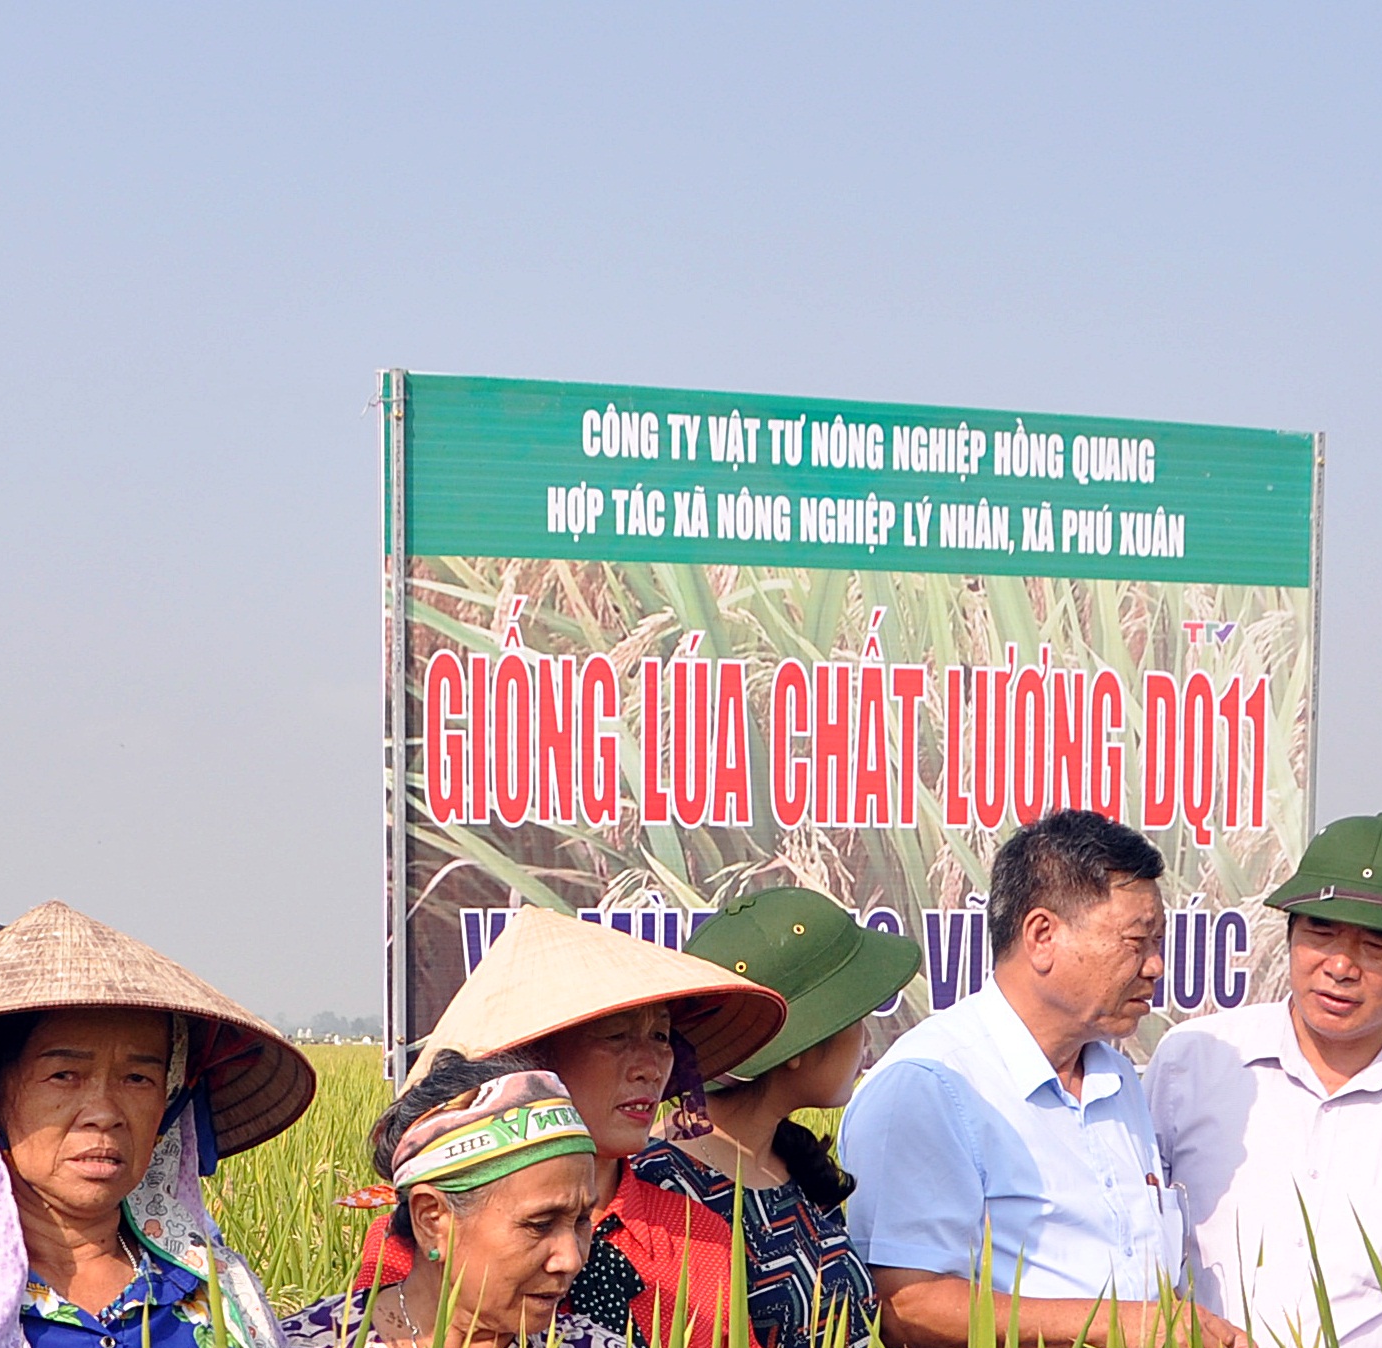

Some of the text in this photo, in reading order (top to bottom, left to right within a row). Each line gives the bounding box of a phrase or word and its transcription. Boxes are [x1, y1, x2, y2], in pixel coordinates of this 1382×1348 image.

[581, 403, 1155, 484] CÔNG TY VẬT TƯ NÔNG NGHIỆP HỒNG QUANG
[547, 481, 1185, 558] HỢP TÁC XÃ NÔNG NGHIỆP LÝ NHÂN, XÃ PHÚ XUÂN
[423, 594, 621, 828] GIỐNG
[640, 630, 754, 829] LÚA
[769, 606, 928, 830] CHẤT
[1141, 669, 1269, 848] DQ11
